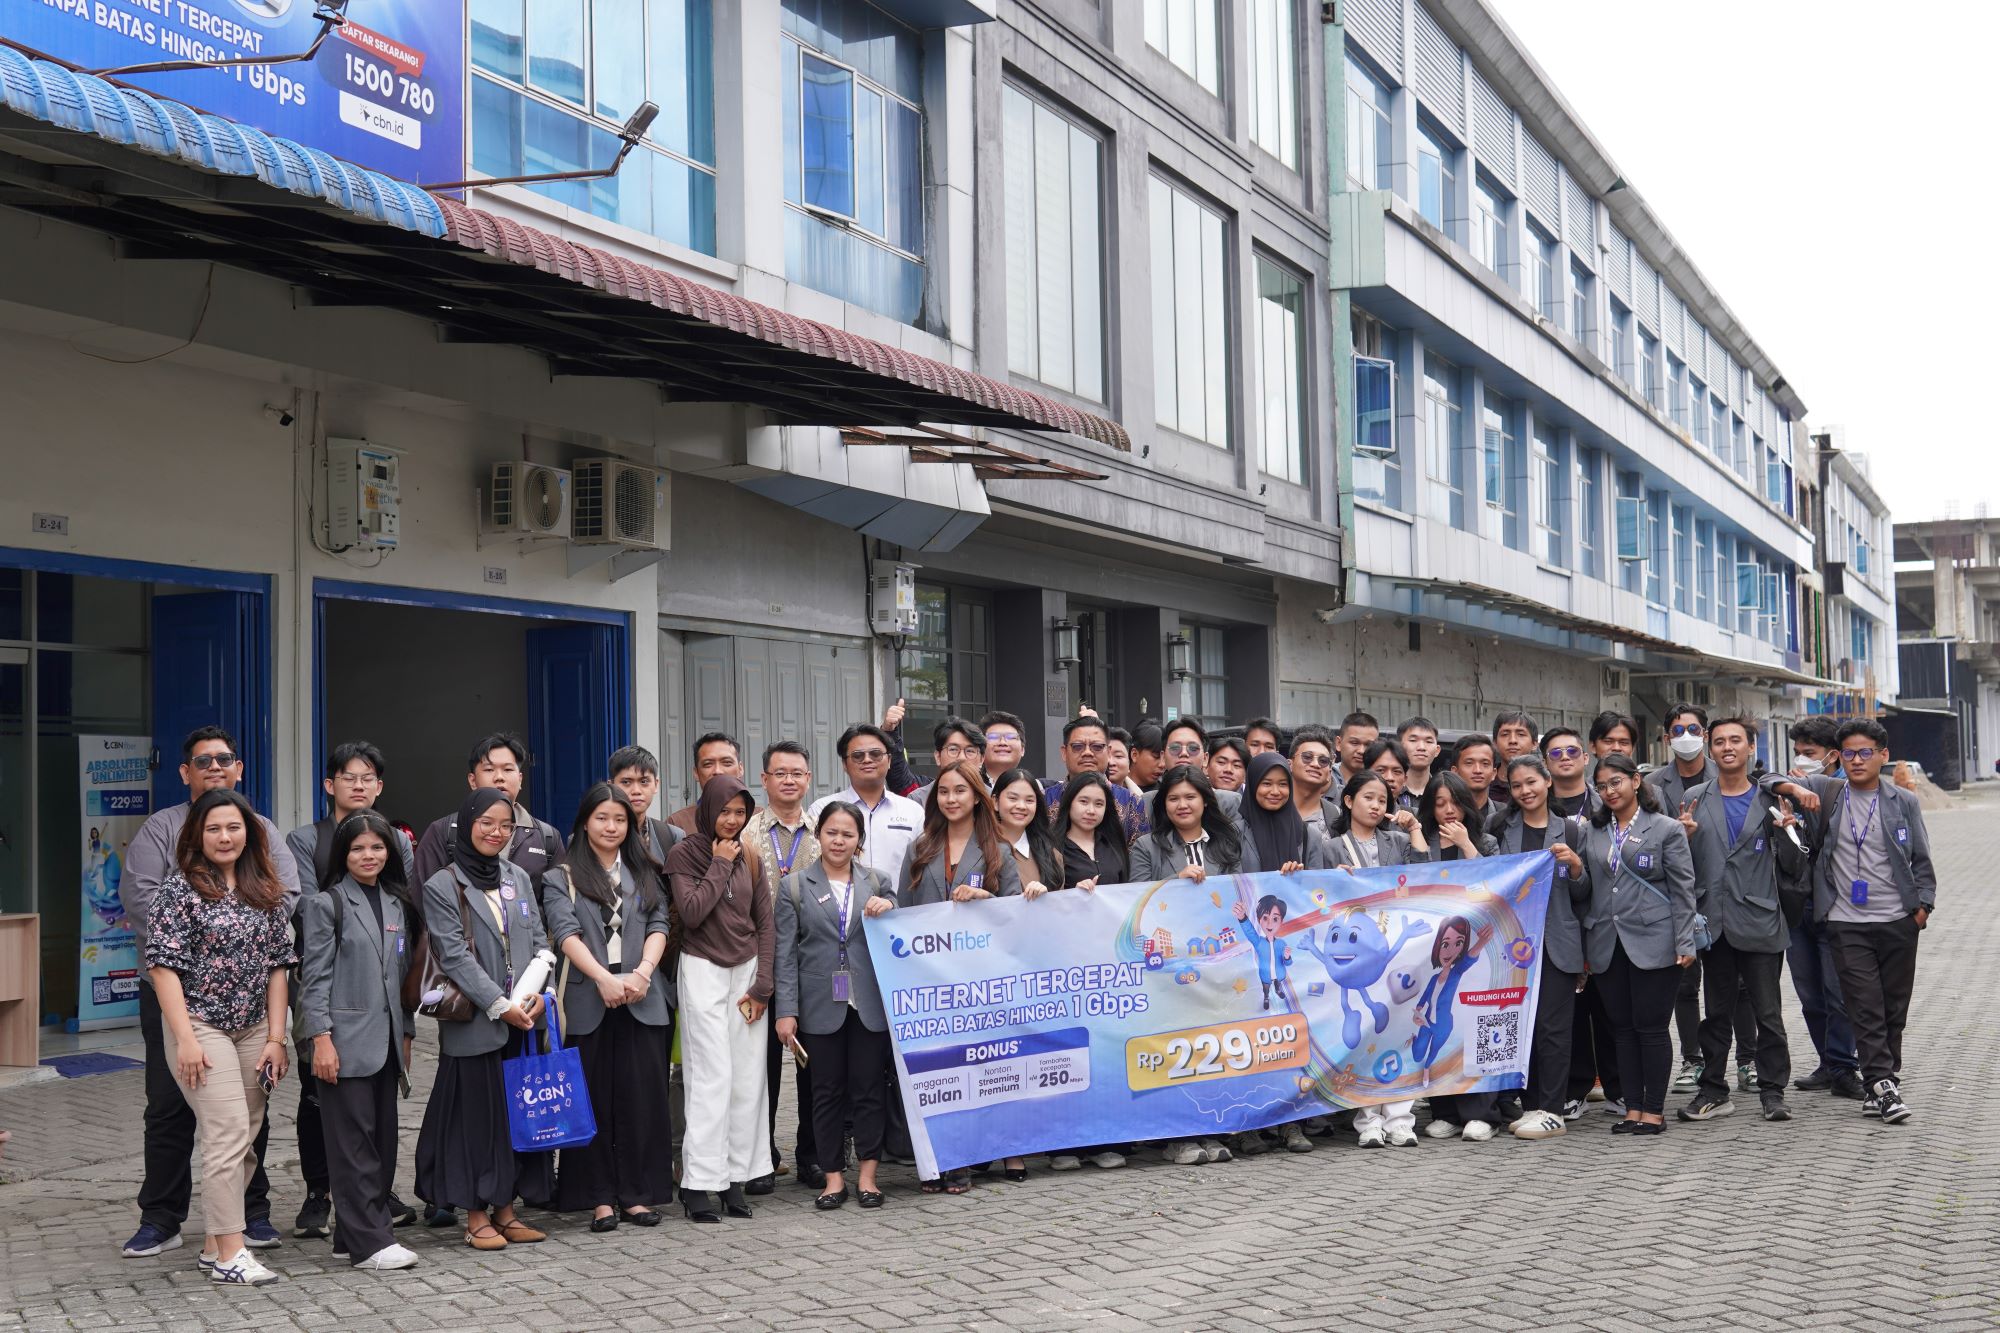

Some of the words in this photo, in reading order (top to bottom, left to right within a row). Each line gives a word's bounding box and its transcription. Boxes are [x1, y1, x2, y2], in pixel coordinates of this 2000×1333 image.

[176, 1, 263, 54] TERCEPAT
[94, 2, 157, 45] BATAS
[160, 27, 229, 74] HINGGA
[248, 63, 306, 106] Gbps
[341, 25, 374, 47] DAFTAR
[374, 38, 419, 68] SEKARANG!
[345, 52, 394, 98] 1500
[398, 76, 435, 115] 780
[373, 114, 404, 136] cbn.id
[40, 518, 62, 530] E-24
[92, 769, 148, 784] UNLIMITED
[110, 796, 131, 809] 229
[892, 976, 1016, 1016] INTERNET
[1021, 962, 1146, 998] TERCEPAT
[1466, 993, 1500, 1002] HUBUNGI
[1500, 991, 1520, 1000] KAMI
[895, 1017, 949, 1041] TANPA
[952, 1010, 1006, 1034] BATAS
[1009, 1000, 1068, 1026] HINGGA
[1072, 995, 1081, 1018] 1
[1085, 993, 1149, 1018] Gbps
[1137, 1052, 1164, 1072] Rp
[1256, 1048, 1296, 1065] /bulan
[984, 1065, 1012, 1076] Nonton
[1038, 1070, 1069, 1088] 250
[913, 1076, 960, 1090] angganan
[978, 1073, 1020, 1087] Streaming
[538, 1084, 565, 1102] CBN
[919, 1089, 962, 1107] Bulan
[979, 1084, 1020, 1097] Premium
